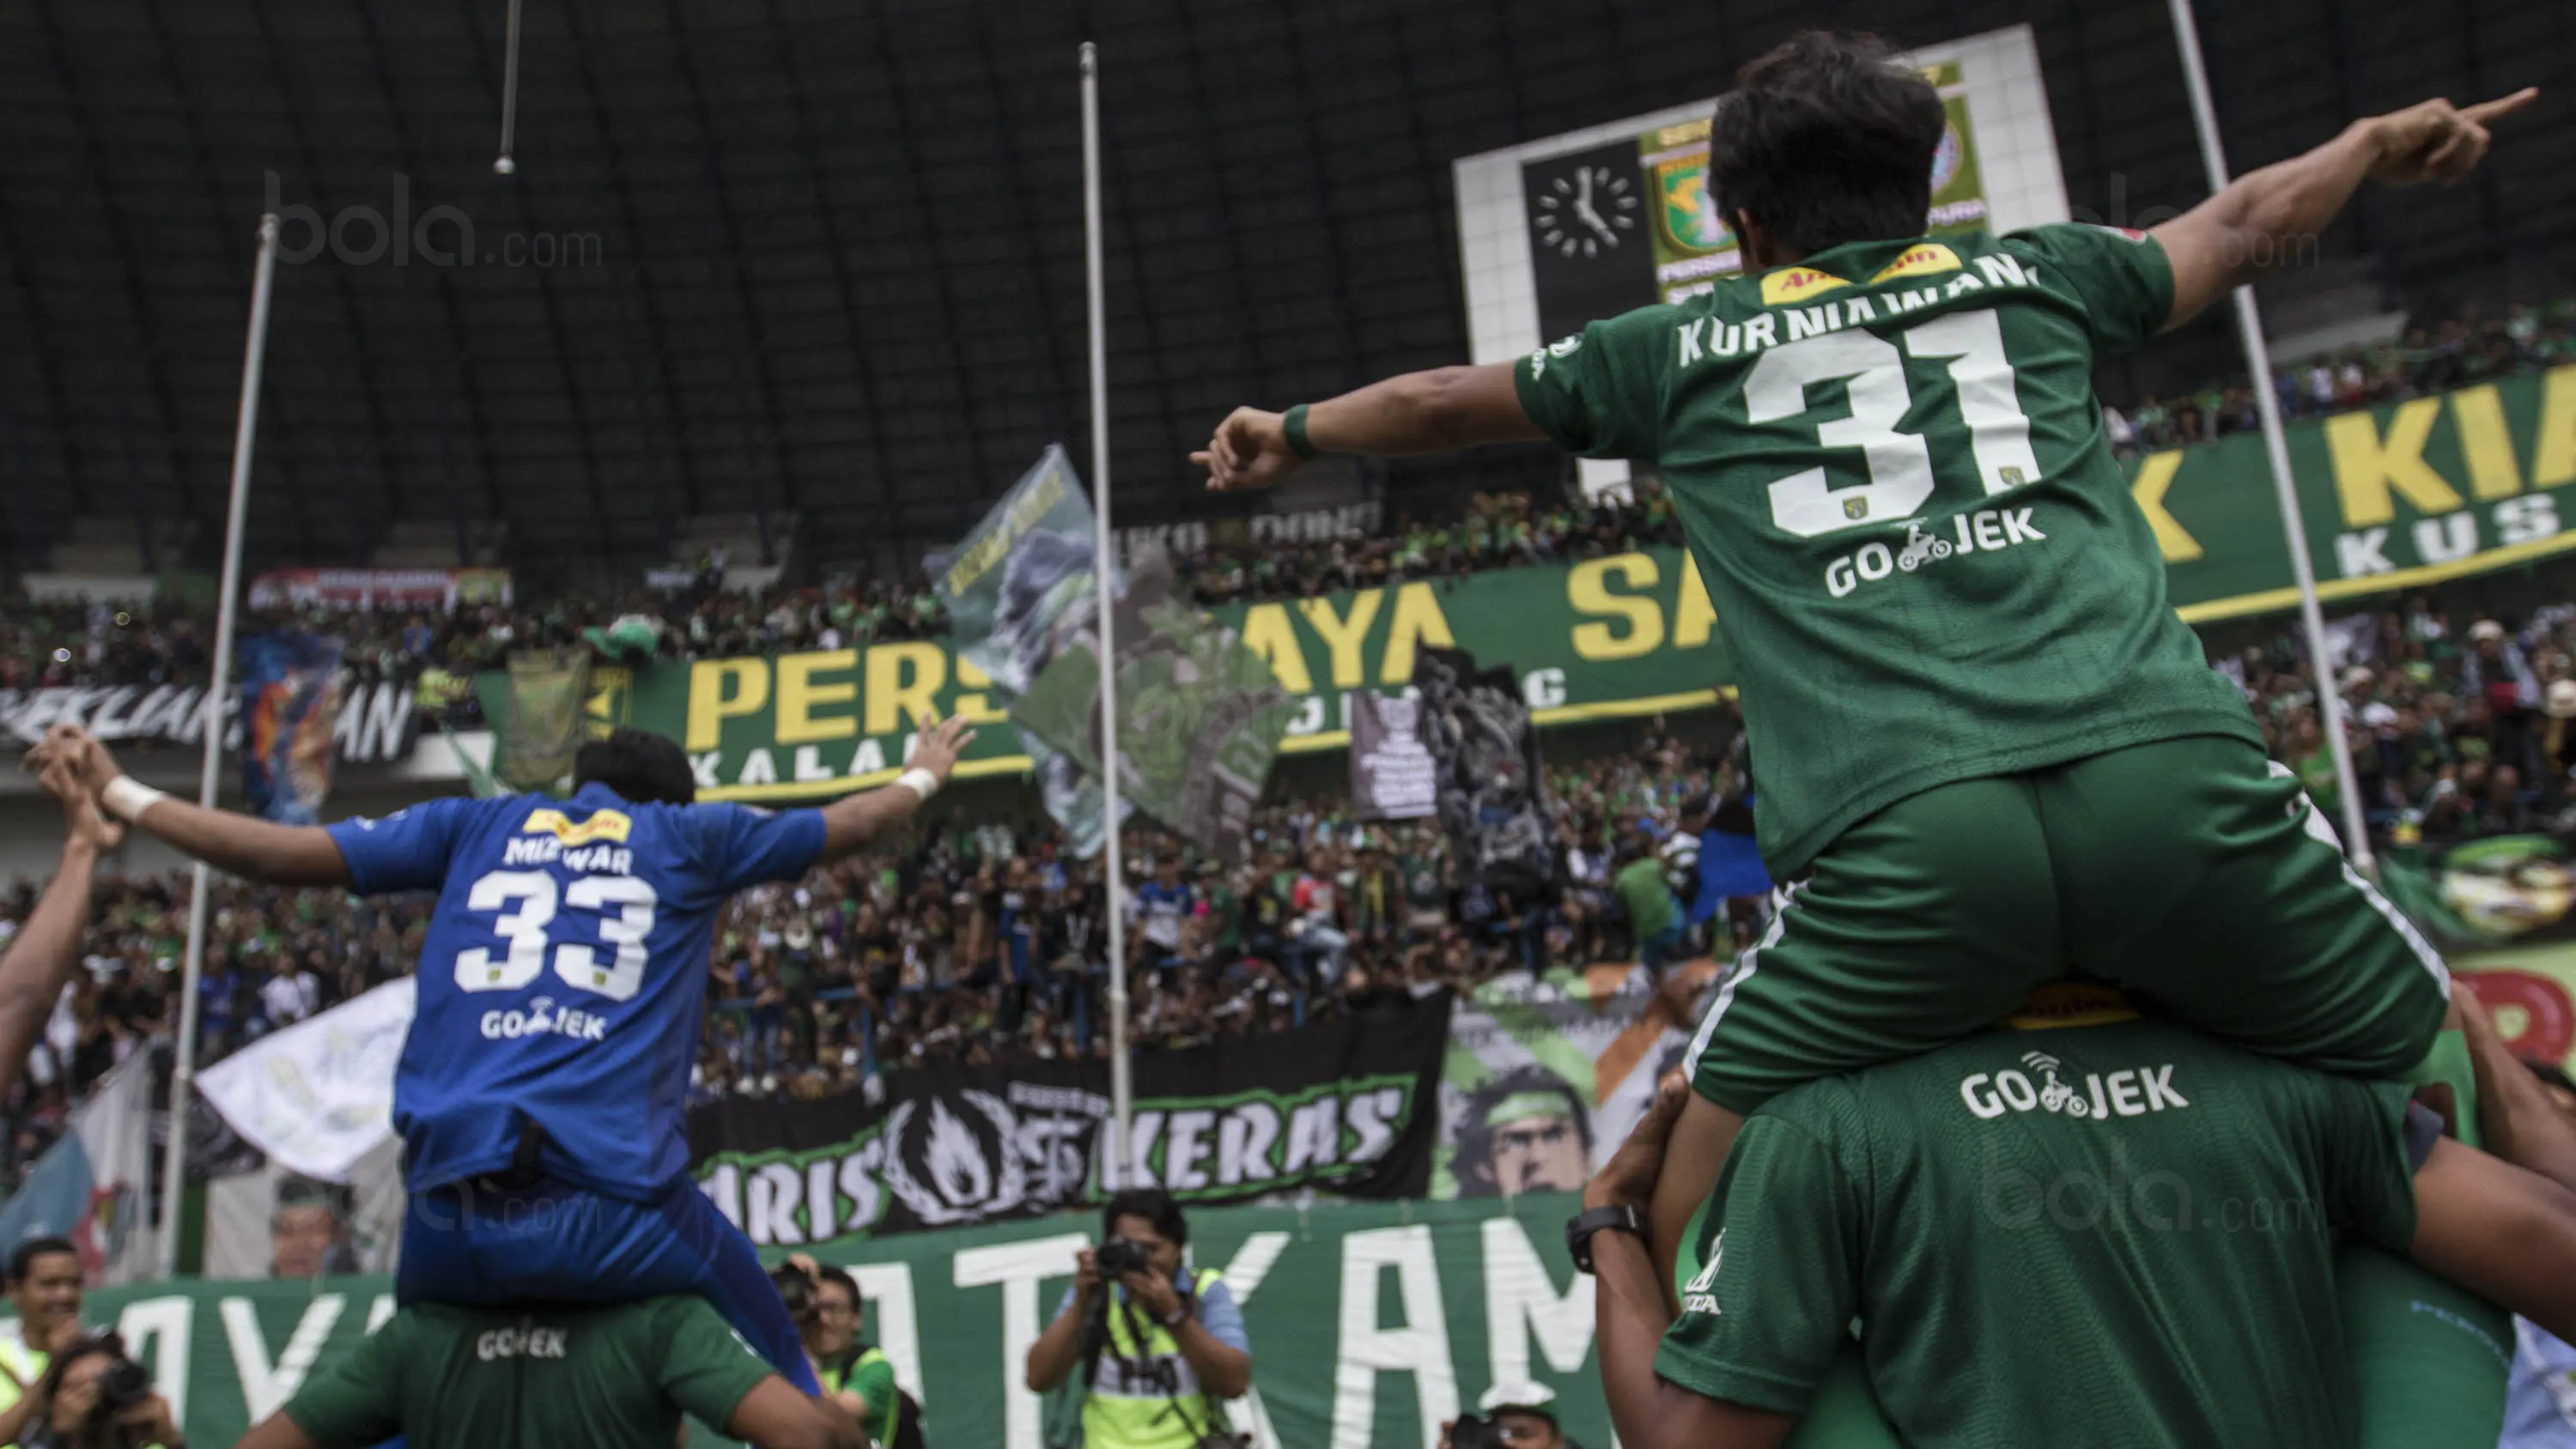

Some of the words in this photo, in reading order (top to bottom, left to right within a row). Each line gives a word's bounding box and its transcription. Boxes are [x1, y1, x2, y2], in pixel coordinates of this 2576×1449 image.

[1743, 308, 2042, 538] 31
[453, 869, 658, 1003] 33
[1101, 1088, 1405, 1193] KERAS
